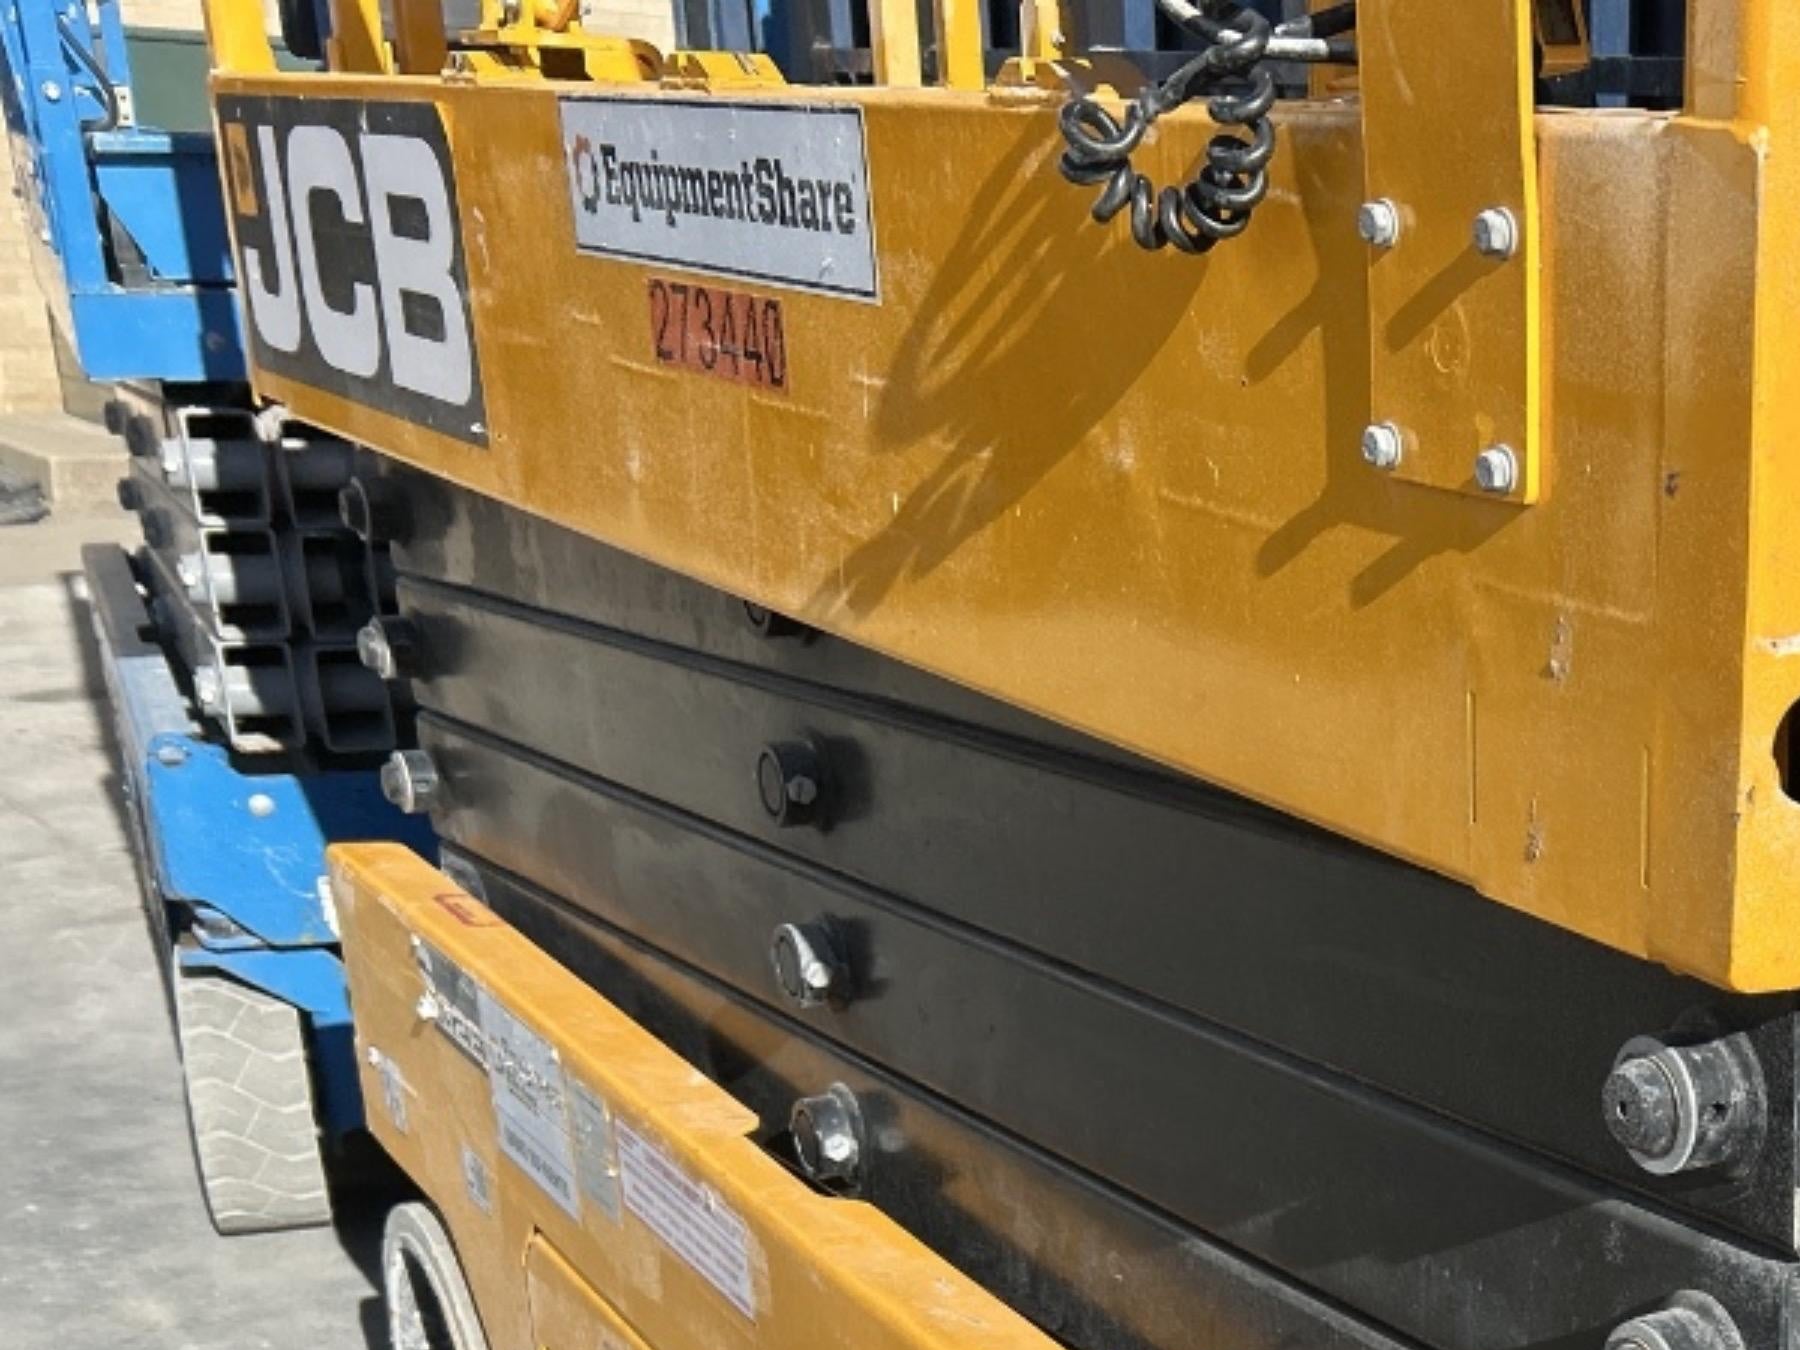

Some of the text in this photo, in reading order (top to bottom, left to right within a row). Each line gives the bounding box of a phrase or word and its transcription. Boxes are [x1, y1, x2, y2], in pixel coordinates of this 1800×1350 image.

[599, 143, 857, 235] EquipmentShare
[245, 124, 473, 406] JCB
[649, 277, 788, 388] 273440
